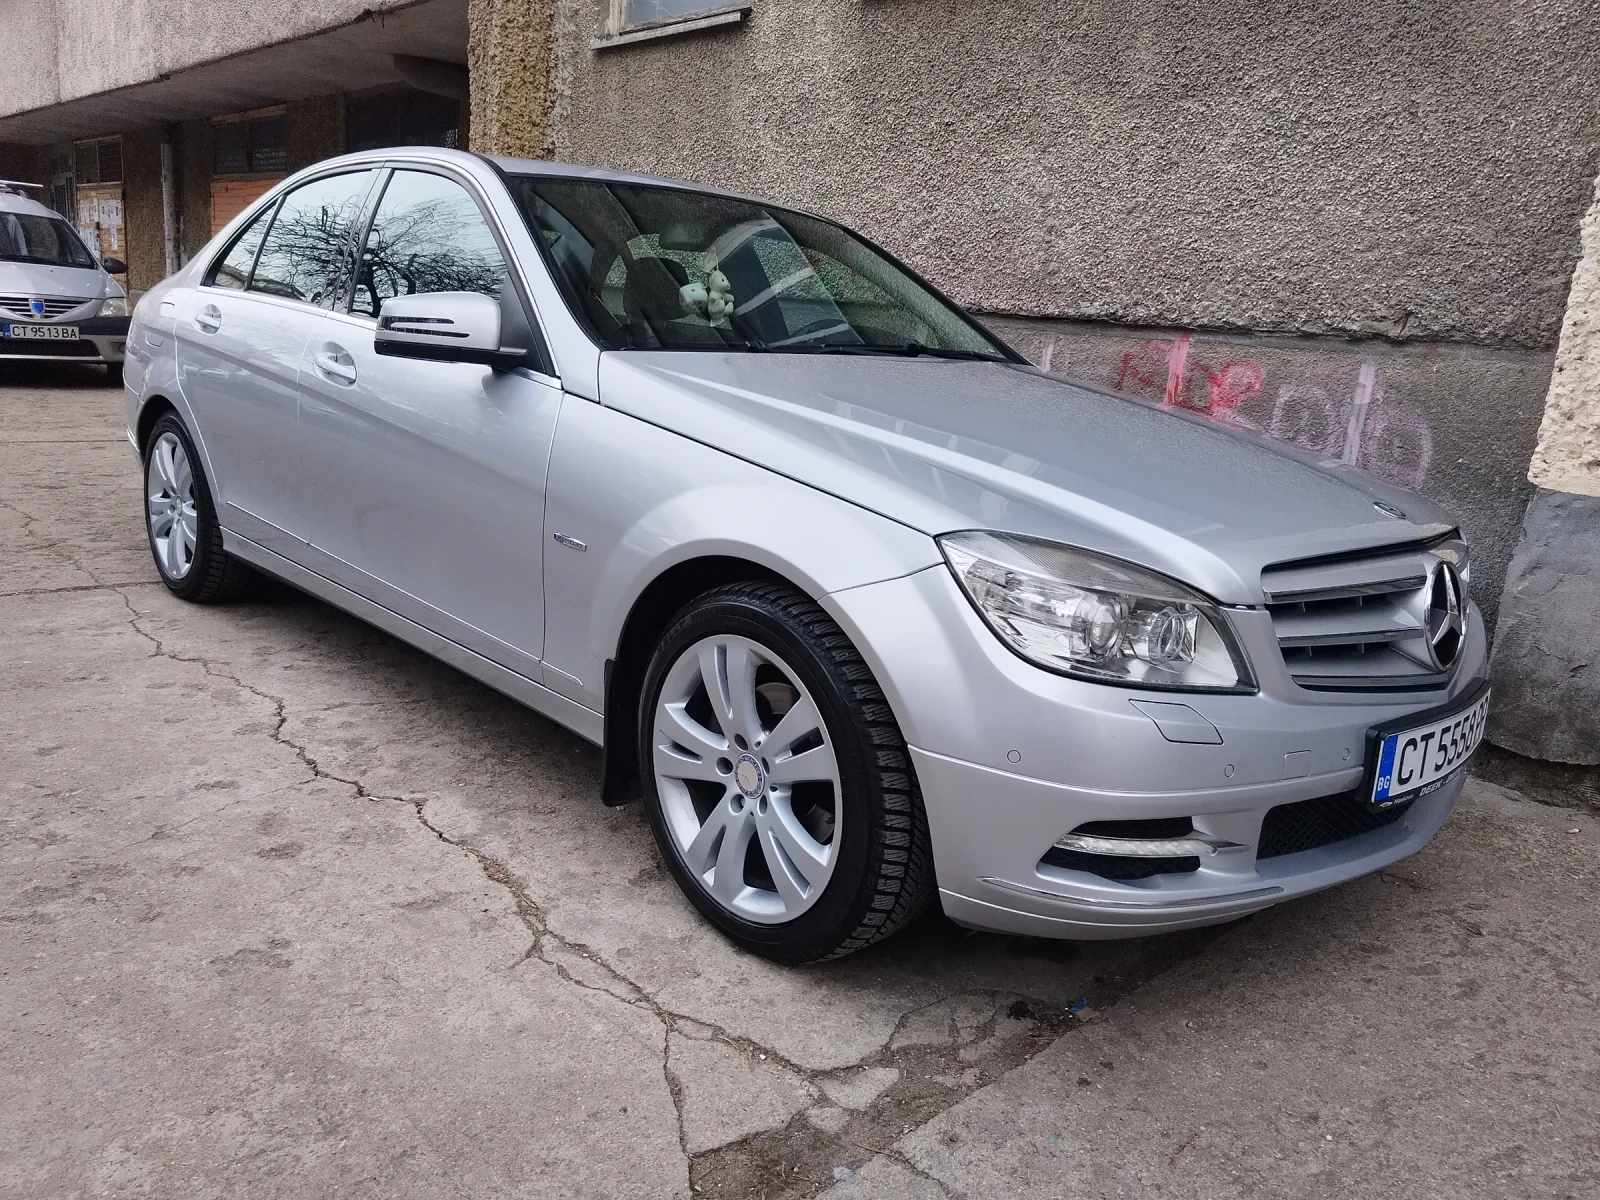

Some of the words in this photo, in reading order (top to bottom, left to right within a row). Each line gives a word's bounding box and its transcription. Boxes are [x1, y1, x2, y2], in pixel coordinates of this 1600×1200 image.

[12, 326, 28, 337] CT
[31, 327, 59, 338] 9513
[62, 328, 77, 338] BA
[1398, 731, 1436, 785] CT
[1434, 710, 1477, 771] 5558
[1377, 775, 1391, 791] BG
